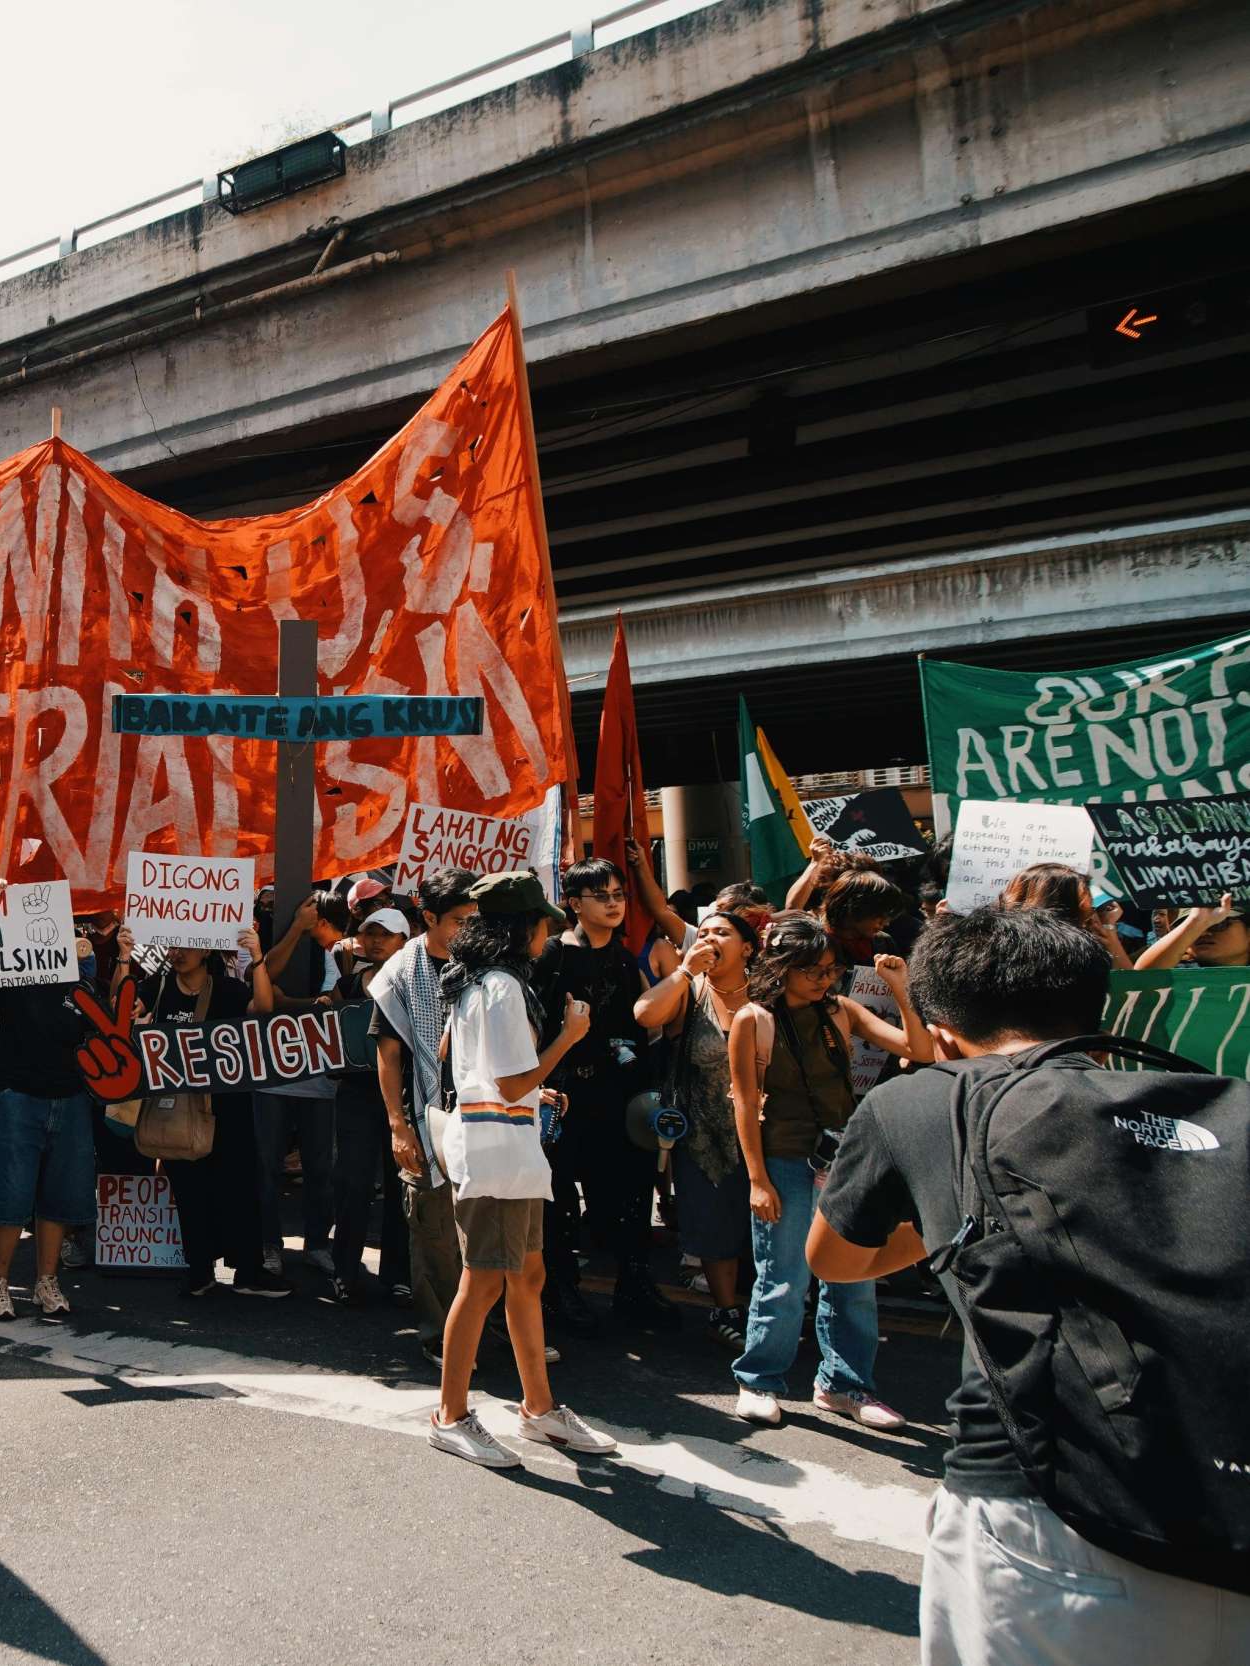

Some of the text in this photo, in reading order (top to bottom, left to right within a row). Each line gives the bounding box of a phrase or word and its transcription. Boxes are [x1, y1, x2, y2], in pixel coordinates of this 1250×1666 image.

[1025, 658, 1196, 724] OUR
[122, 698, 288, 735] BAKANTE
[296, 704, 373, 738] ANG
[956, 723, 1084, 798] ARE
[1087, 696, 1234, 787] NOT
[412, 808, 531, 854] LAHAT NG
[409, 833, 527, 874] SANGKOT
[142, 859, 240, 892] DIGONG
[126, 893, 245, 924] PANAGUTIN
[150, 935, 231, 949] ATENEO ENTABLADO
[1, 974, 59, 988] ENTABLADO
[139, 1009, 346, 1091] RESIGN
[1113, 1114, 1178, 1141] NORTH
[1140, 1109, 1175, 1129] THE
[1134, 1132, 1183, 1151] FACE
[97, 1204, 178, 1225] TRANSIT
[97, 1225, 183, 1245] COUNCIL
